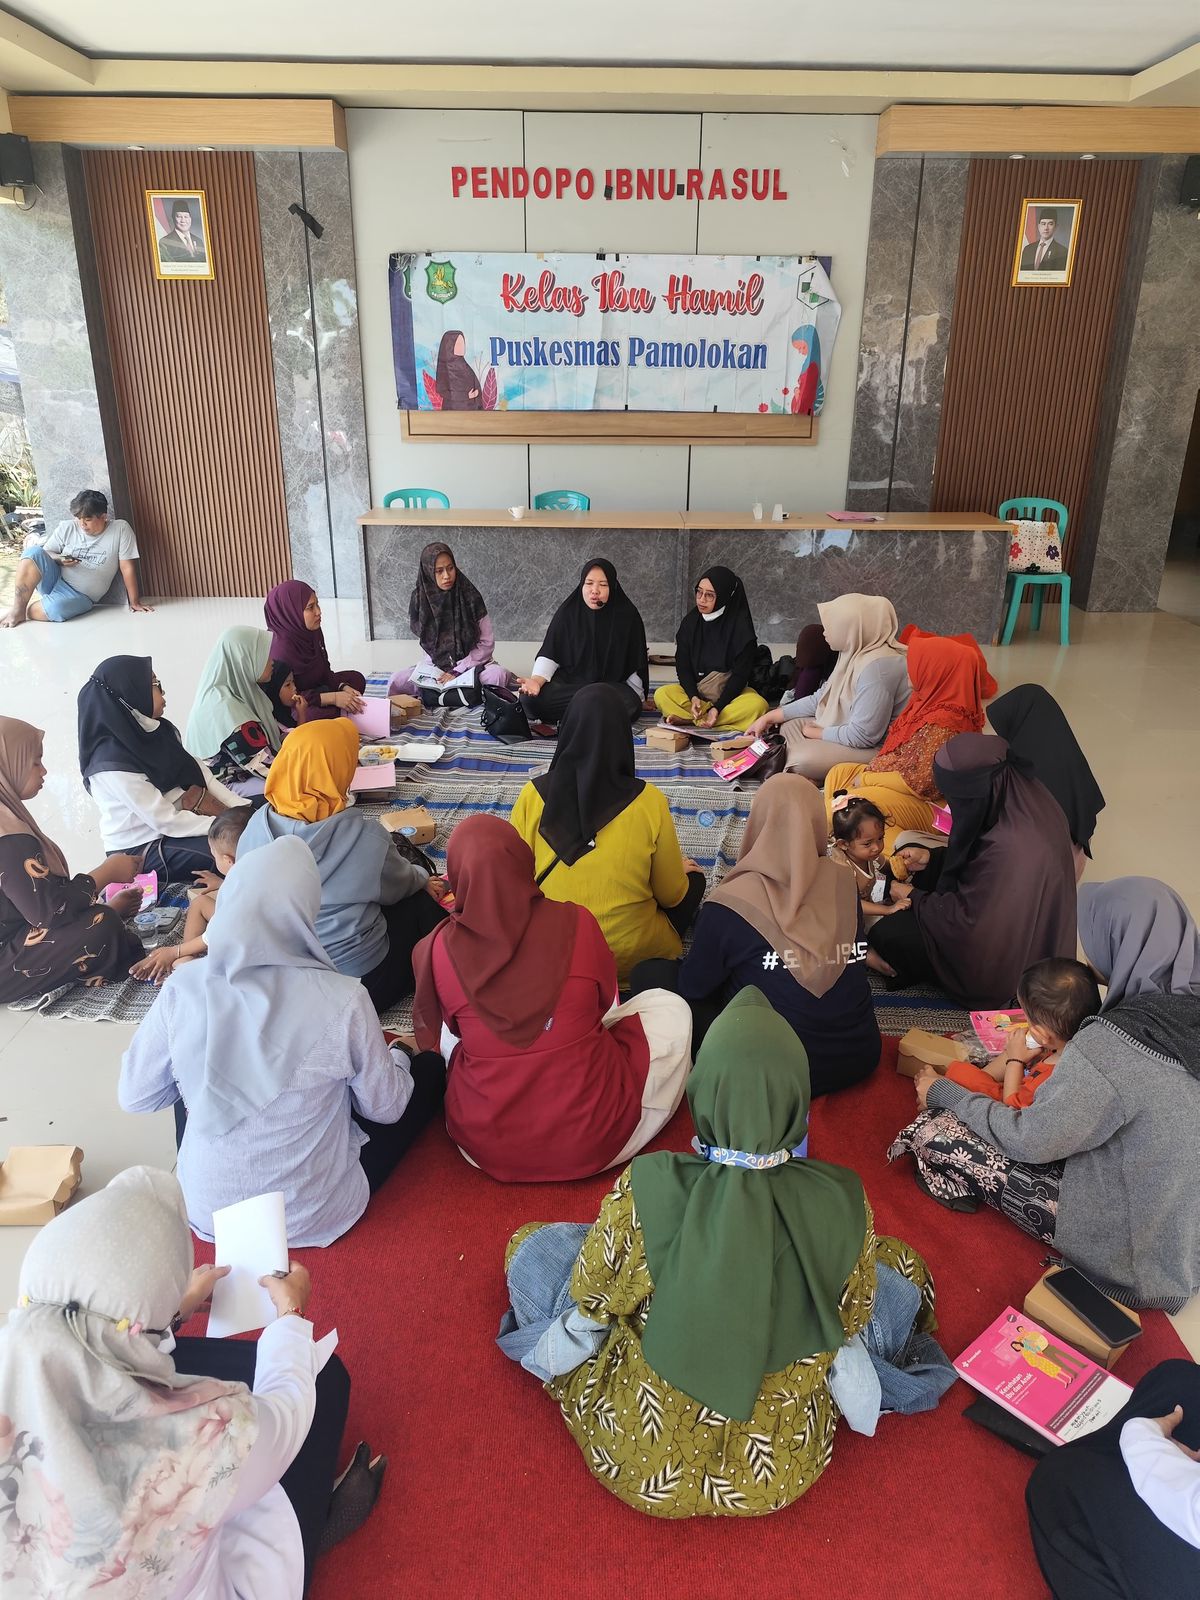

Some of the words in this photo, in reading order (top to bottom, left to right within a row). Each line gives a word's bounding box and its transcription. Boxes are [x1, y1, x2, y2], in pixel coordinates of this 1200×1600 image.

[451, 166, 595, 200] PENDOPO
[604, 168, 676, 200] IBNU
[686, 167, 788, 200] RASUL
[500, 270, 588, 315] Kelas
[591, 269, 656, 313] Ibu
[661, 272, 765, 316] Hamil
[488, 336, 621, 369] Puskesmas
[628, 337, 768, 370] Pamolokan
